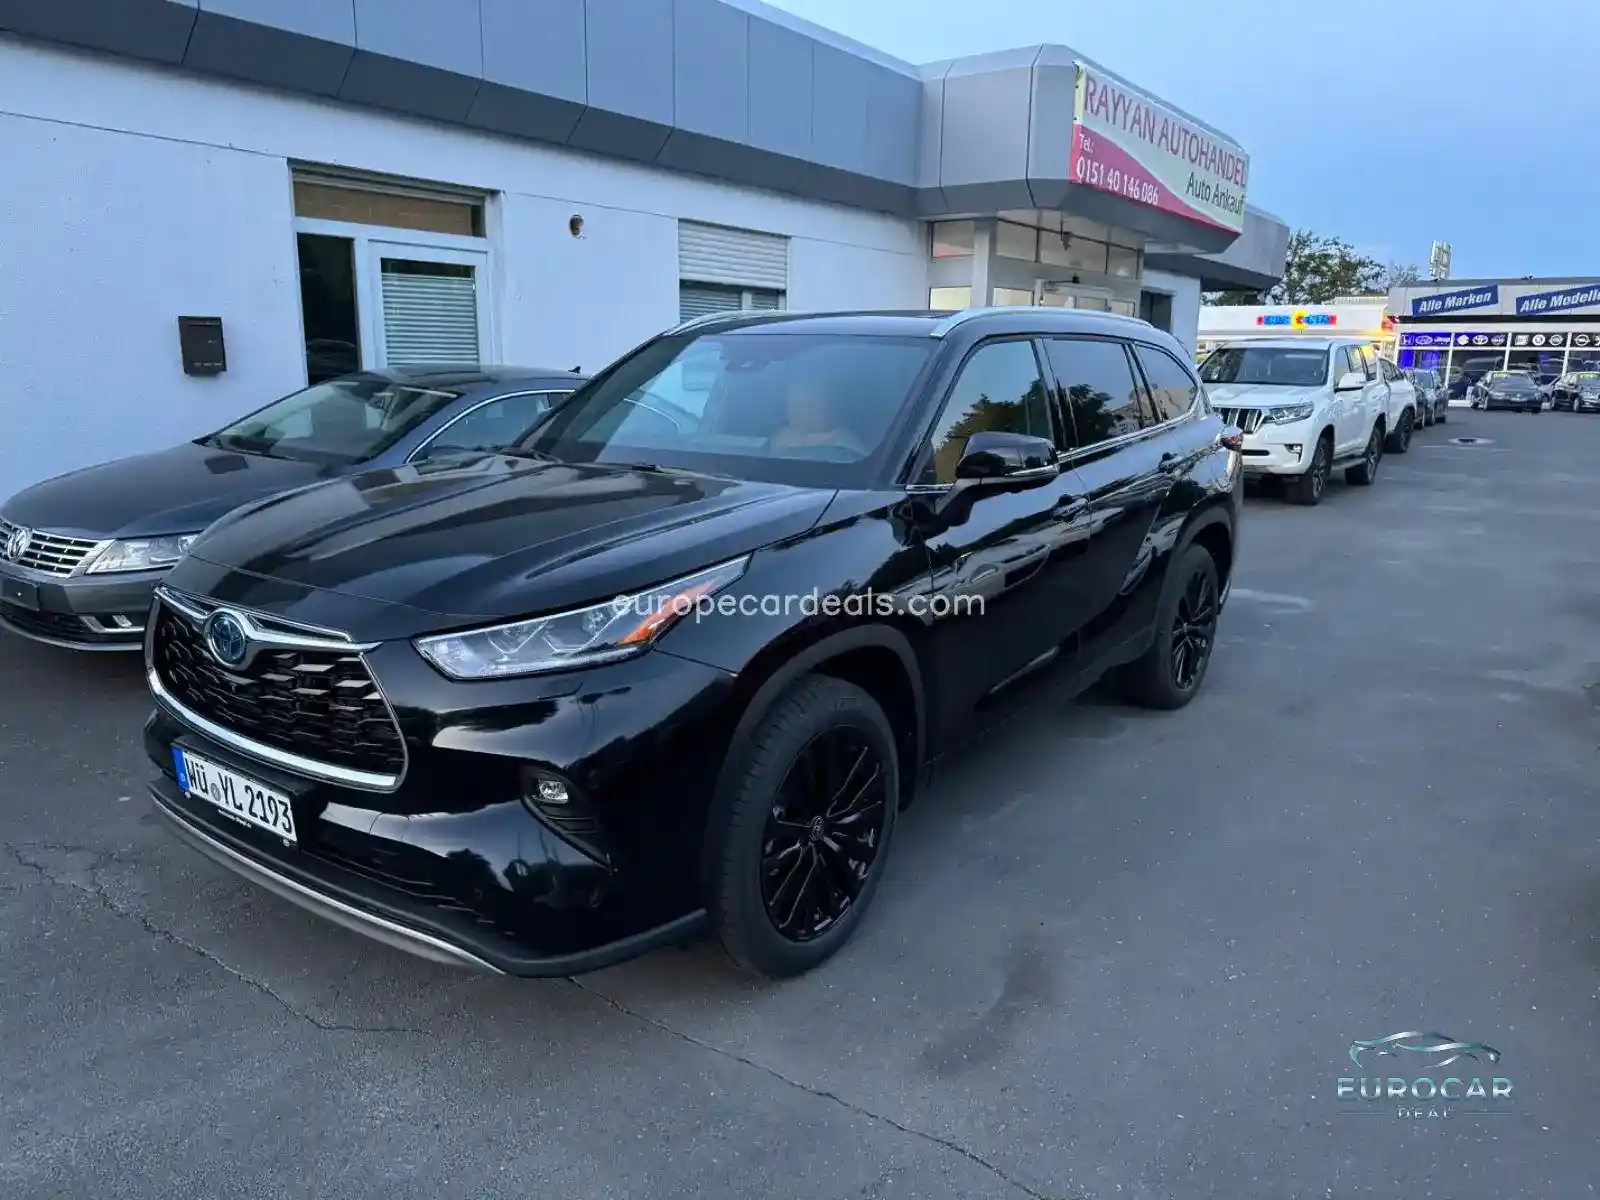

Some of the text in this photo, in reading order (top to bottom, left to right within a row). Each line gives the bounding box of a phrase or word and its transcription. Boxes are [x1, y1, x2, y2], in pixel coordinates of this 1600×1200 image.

[1084, 73, 1246, 188] RAYYAN AUTOHANDEL
[1076, 156, 1158, 205] 0151 40 146 086
[1186, 171, 1245, 216] Auto Ankauf
[1419, 292, 1492, 313] Alle Marken
[1520, 299, 1547, 312] Alle
[217, 772, 244, 811] YL
[244, 785, 293, 834] 2193
